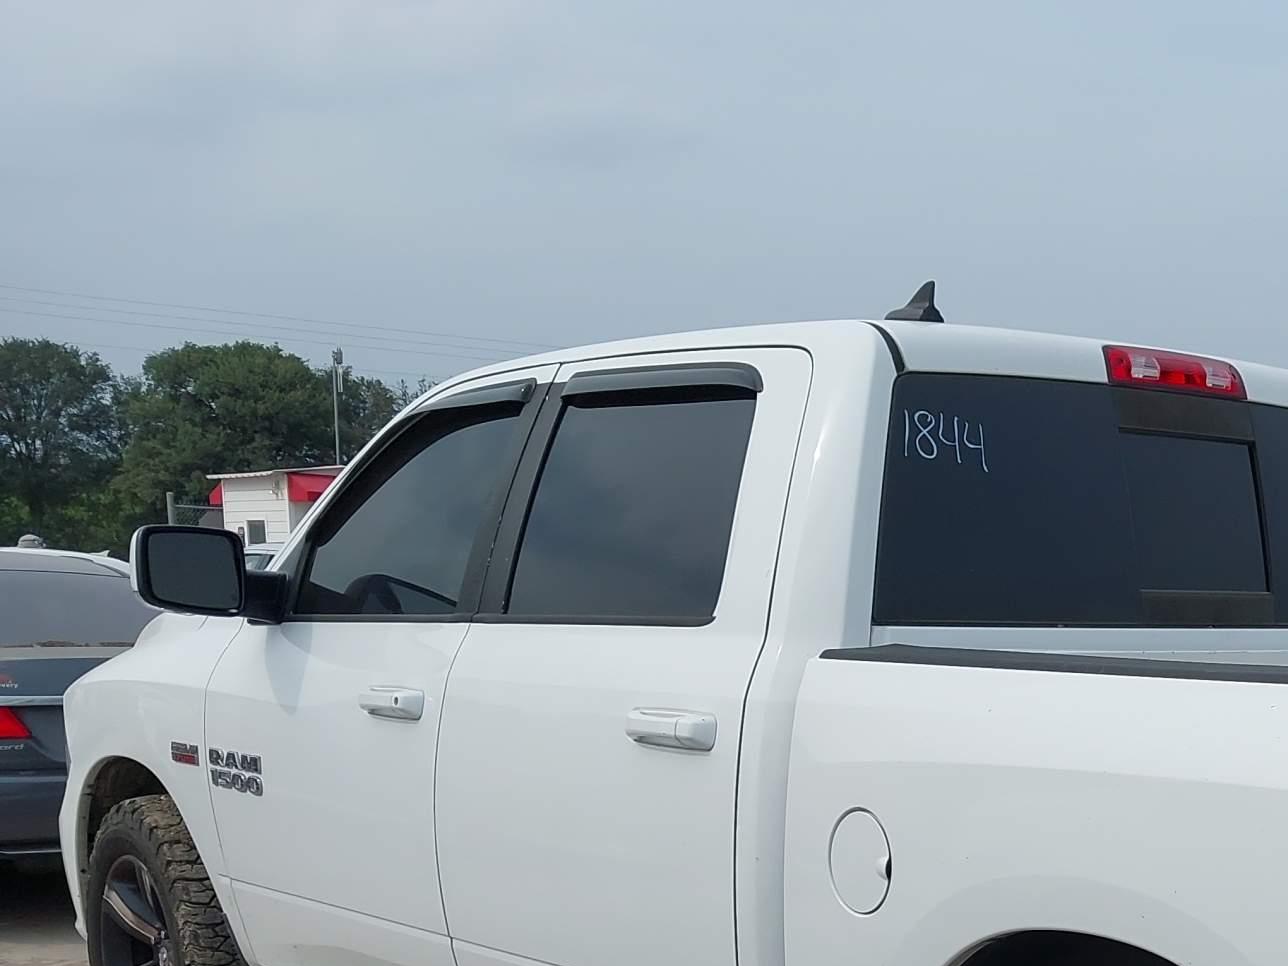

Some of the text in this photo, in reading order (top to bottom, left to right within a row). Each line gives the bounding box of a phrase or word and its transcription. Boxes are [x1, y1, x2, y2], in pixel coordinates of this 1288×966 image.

[904, 408, 989, 473] 1844
[208, 747, 262, 775] RAM
[209, 767, 264, 797] 1500
